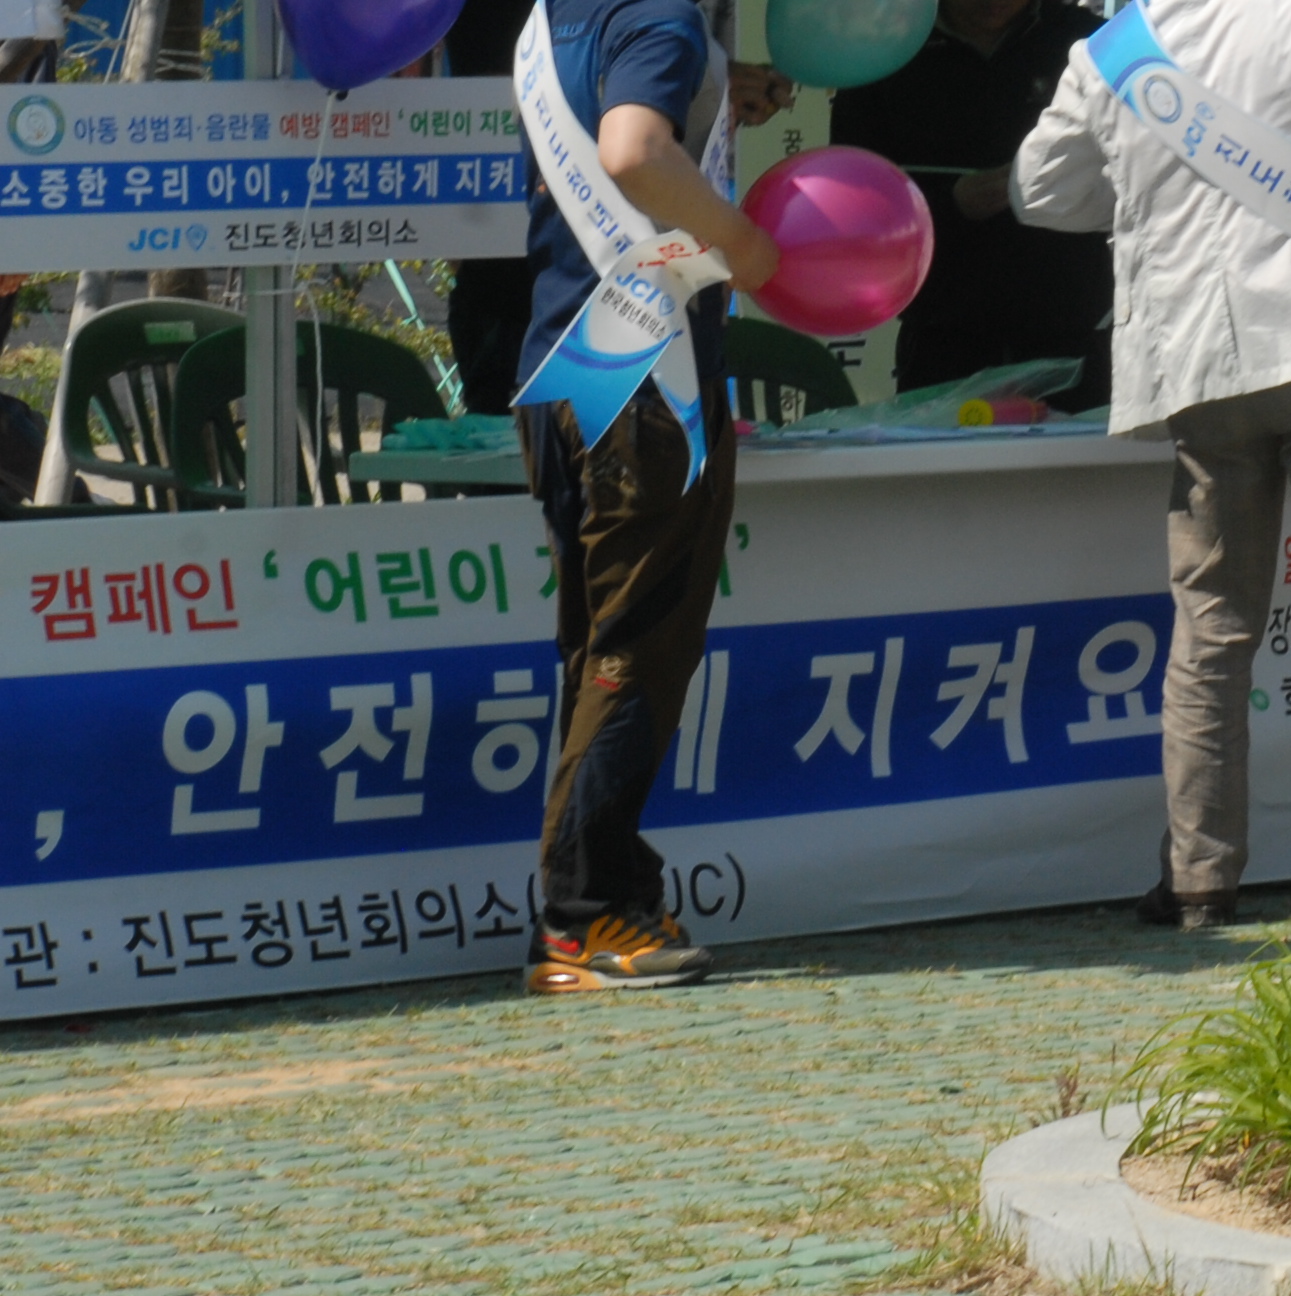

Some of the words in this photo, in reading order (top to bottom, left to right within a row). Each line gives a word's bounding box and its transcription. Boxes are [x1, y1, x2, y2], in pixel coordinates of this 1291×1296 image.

[74, 116, 118, 144] 아동
[280, 111, 323, 140] 예방
[329, 109, 391, 139] 캠페인
[1, 165, 107, 208] 소중한
[122, 163, 190, 206] 우리
[206, 161, 290, 205] 아이,
[307, 158, 441, 201] 안전하게
[455, 156, 527, 197] 지켜
[128, 226, 182, 253] JCI
[223, 217, 420, 252] 진도청년회의소
[615, 271, 662, 304] JCI
[31, 558, 240, 641] 캠페인
[794, 620, 1163, 779] 지켜요
[2, 924, 58, 989] 관
